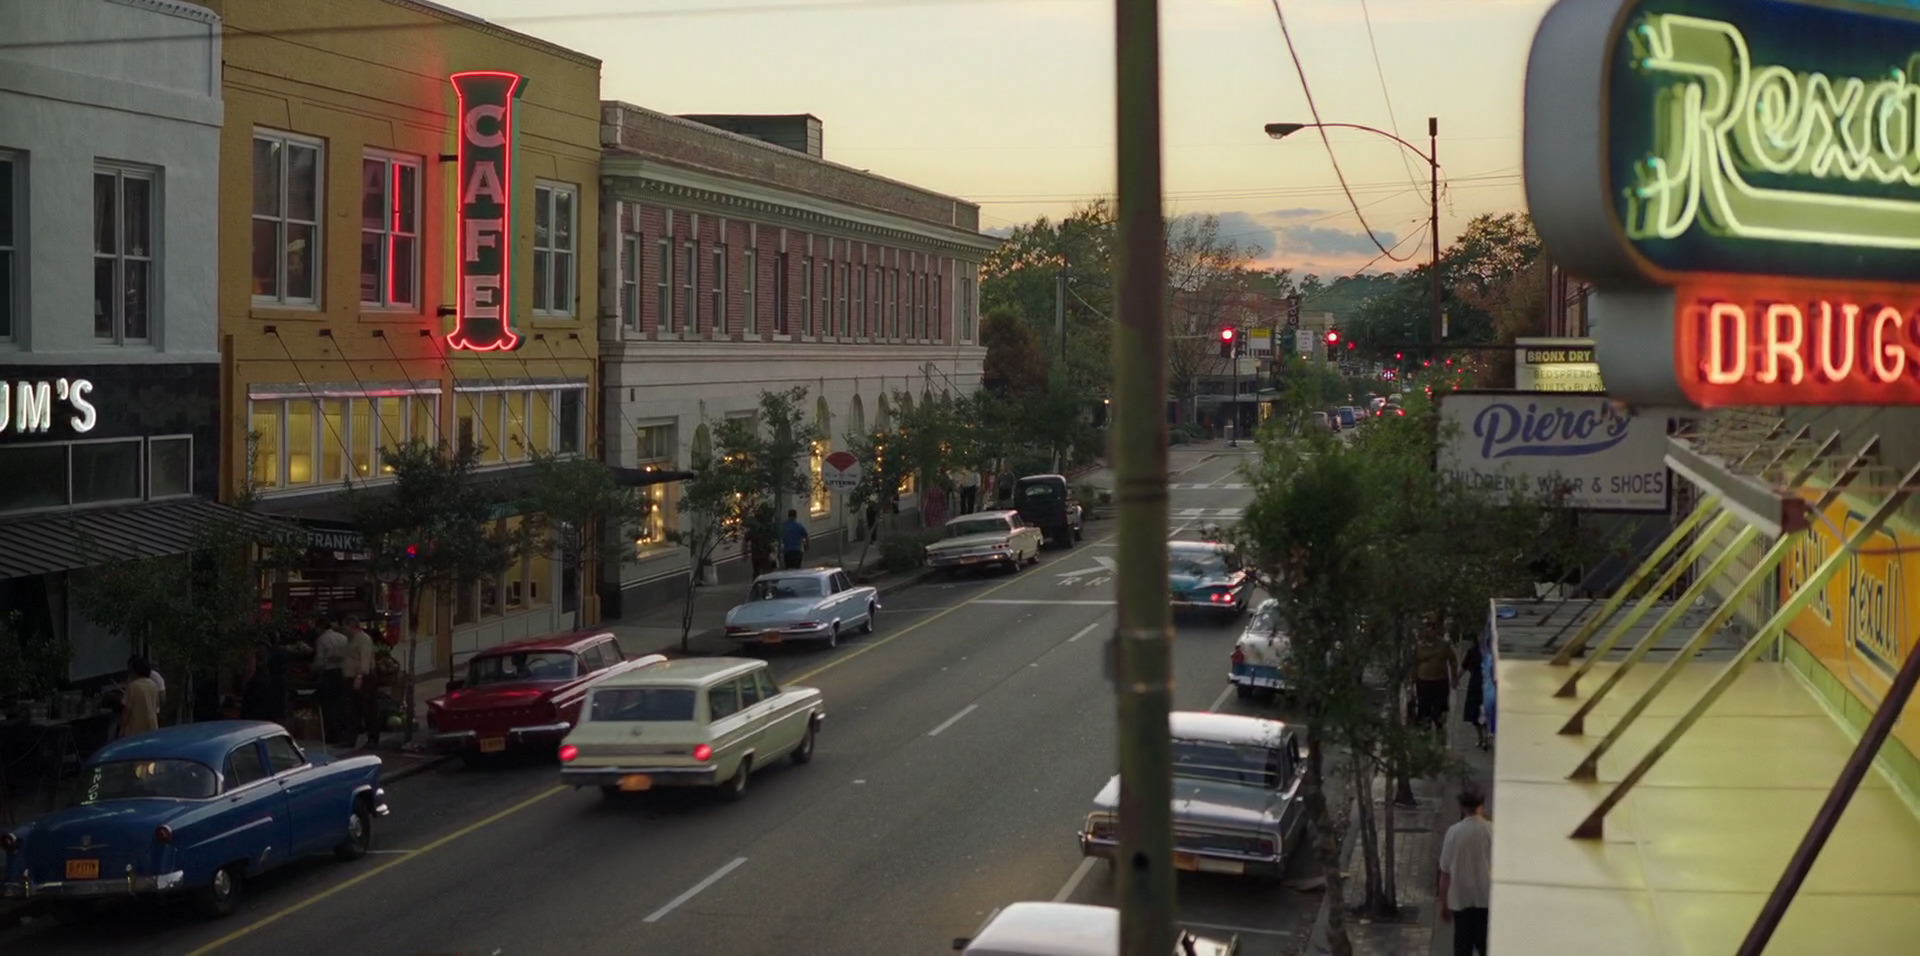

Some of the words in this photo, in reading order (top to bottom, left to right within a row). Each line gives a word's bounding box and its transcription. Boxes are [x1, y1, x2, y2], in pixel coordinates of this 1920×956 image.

[463, 104, 507, 320] CAFE
[1527, 350, 1566, 362] BRONX
[1568, 350, 1592, 362] DRY
[1700, 301, 1920, 386] DRUG
[1473, 402, 1631, 459] Piero's
[1592, 477, 1603, 493] &
[1611, 471, 1664, 494] SHOES
[306, 531, 364, 551] FRANK'S
[1845, 551, 1900, 660] Rexall
